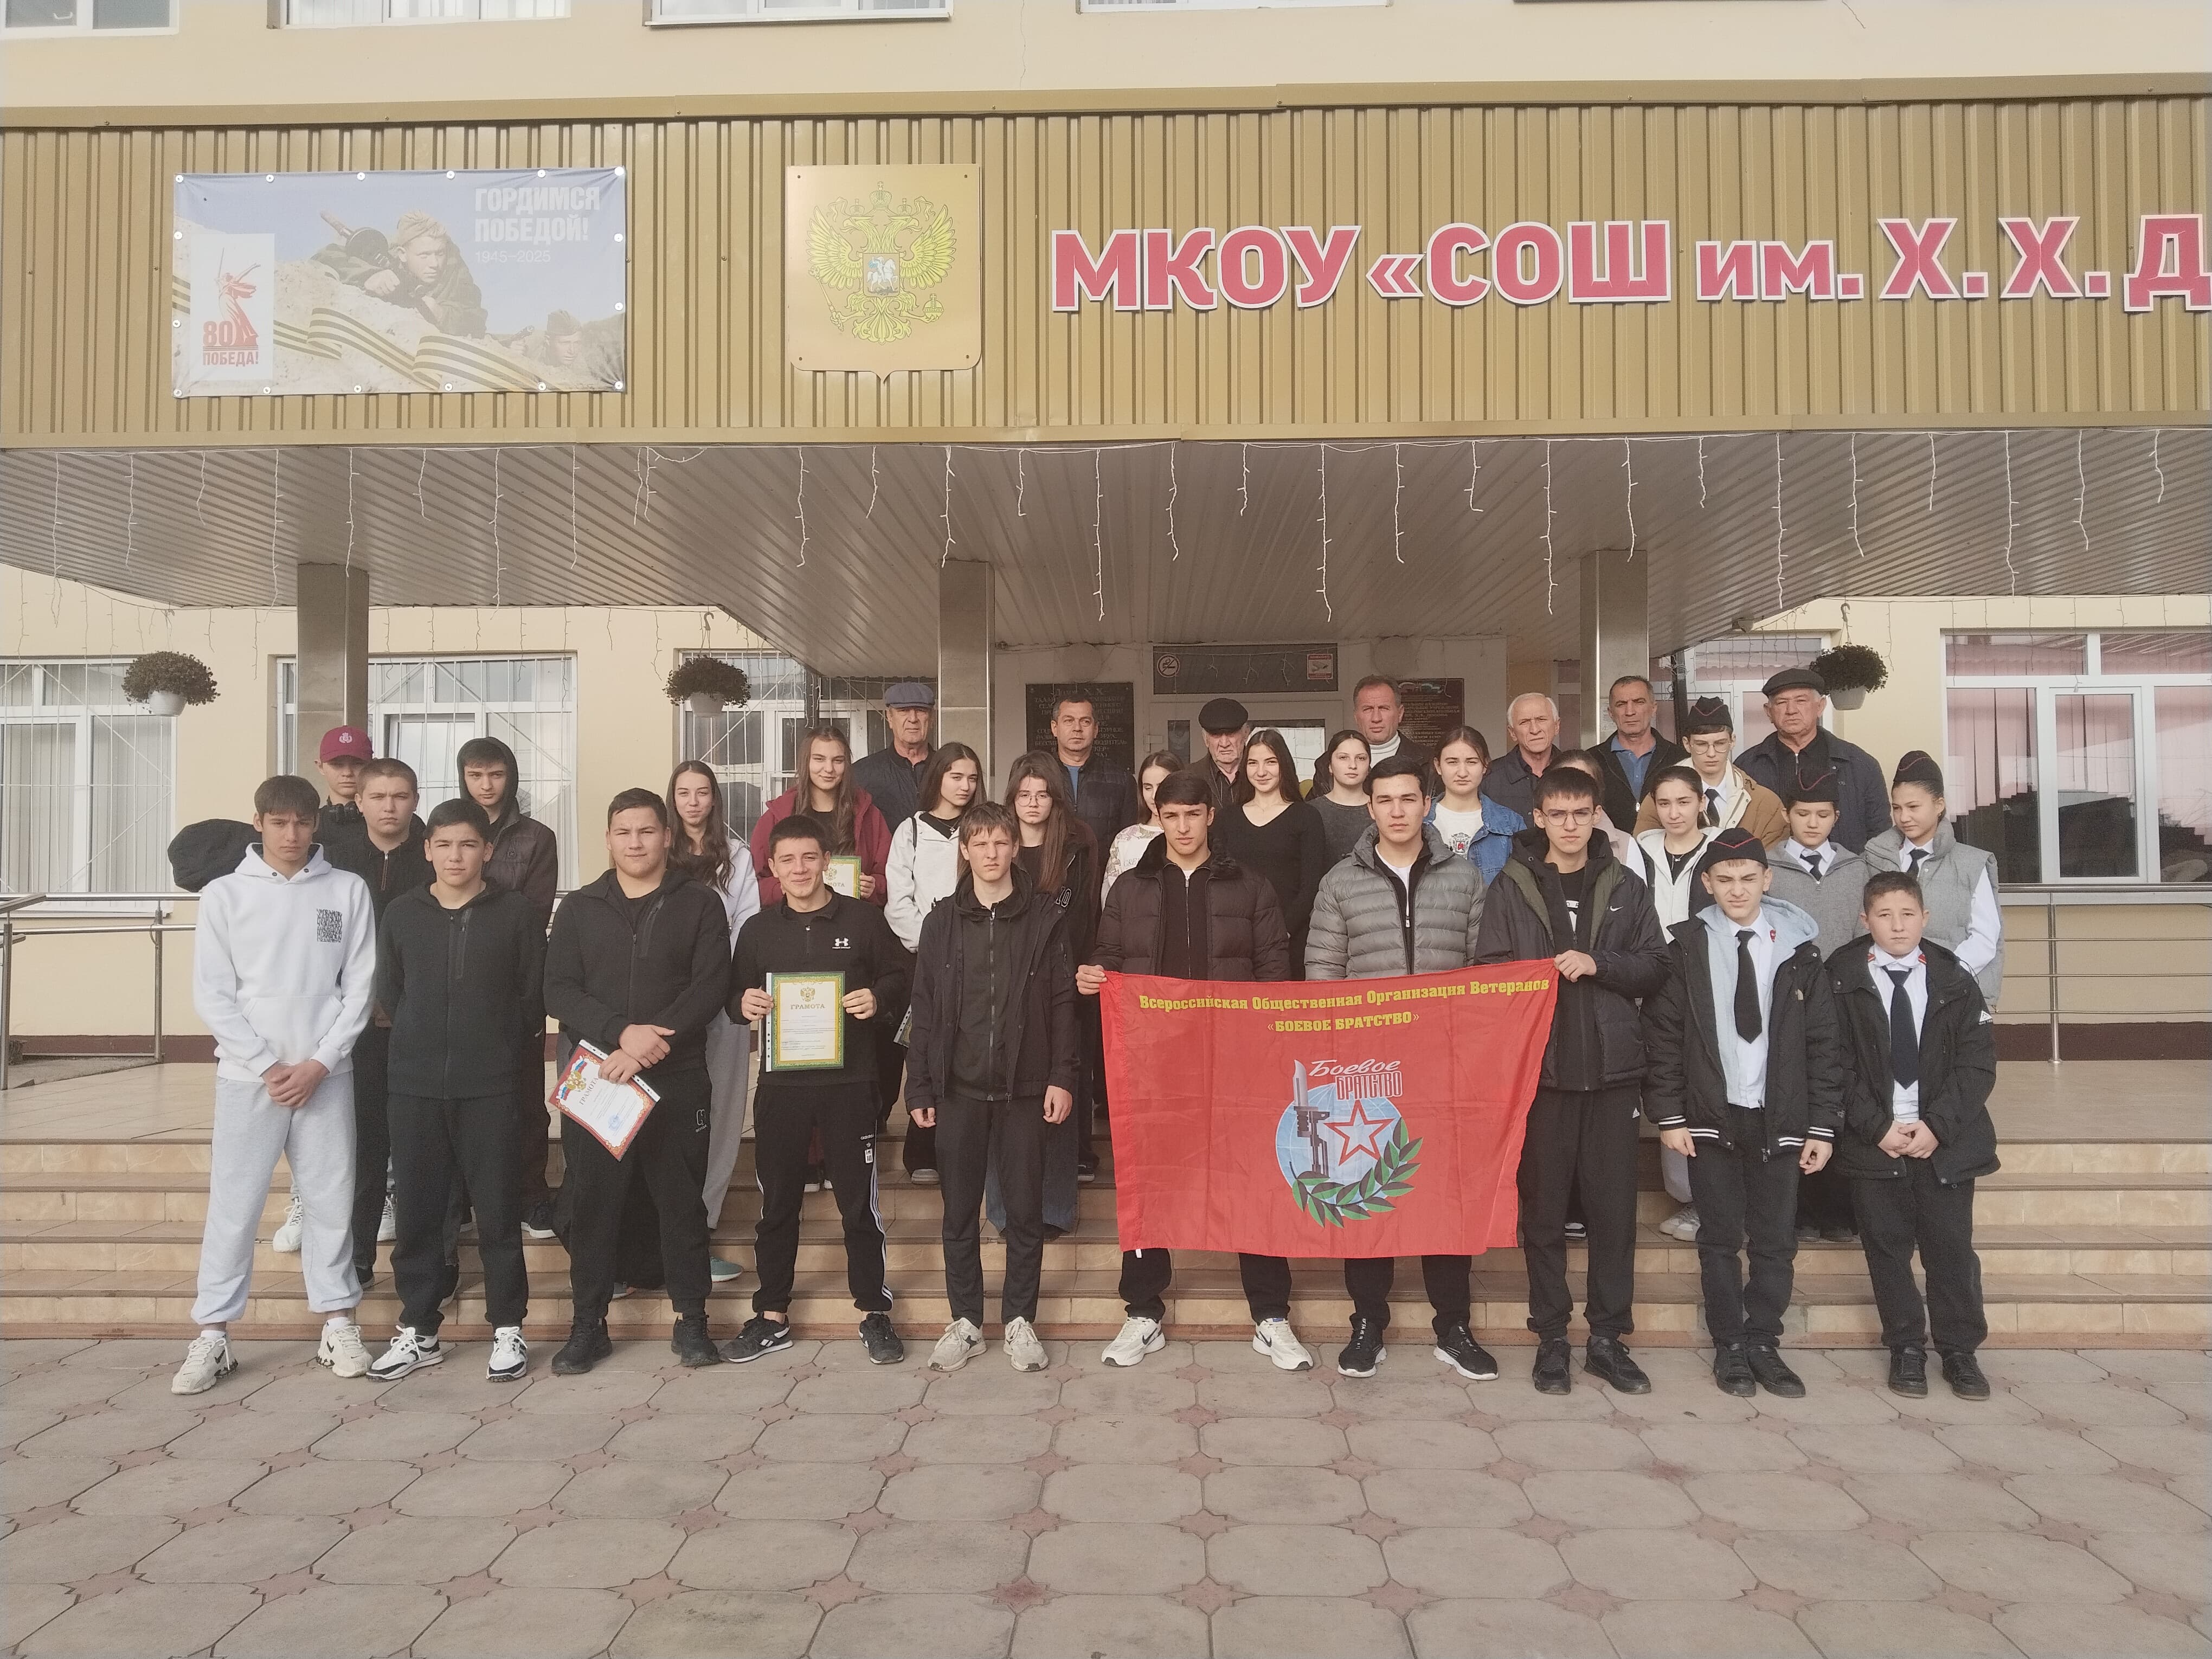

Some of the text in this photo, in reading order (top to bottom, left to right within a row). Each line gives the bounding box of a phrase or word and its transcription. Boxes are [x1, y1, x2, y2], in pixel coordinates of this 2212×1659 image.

[475, 186, 600, 215] ГОРДИМСЯ
[475, 214, 588, 245] ПОБЕДОЙ!
[1051, 224, 1361, 312] МКОУ
[1365, 220, 1670, 307] «СОШ
[1695, 239, 1864, 301] им.
[2123, 213, 2212, 312] Д
[203, 320, 235, 348] 80
[202, 351, 259, 366] ПОБЕДА!
[1140, 979, 1549, 1013] Всероссийская Общественная Организация Ветеранов
[1267, 1011, 1420, 1033] «БОЕВОЕ БРАТСТВО»
[1308, 1058, 1401, 1078] Боевое
[578, 1077, 599, 1105] ГРАМОТА
[1335, 1070, 1403, 1101] БРАТСТВО
